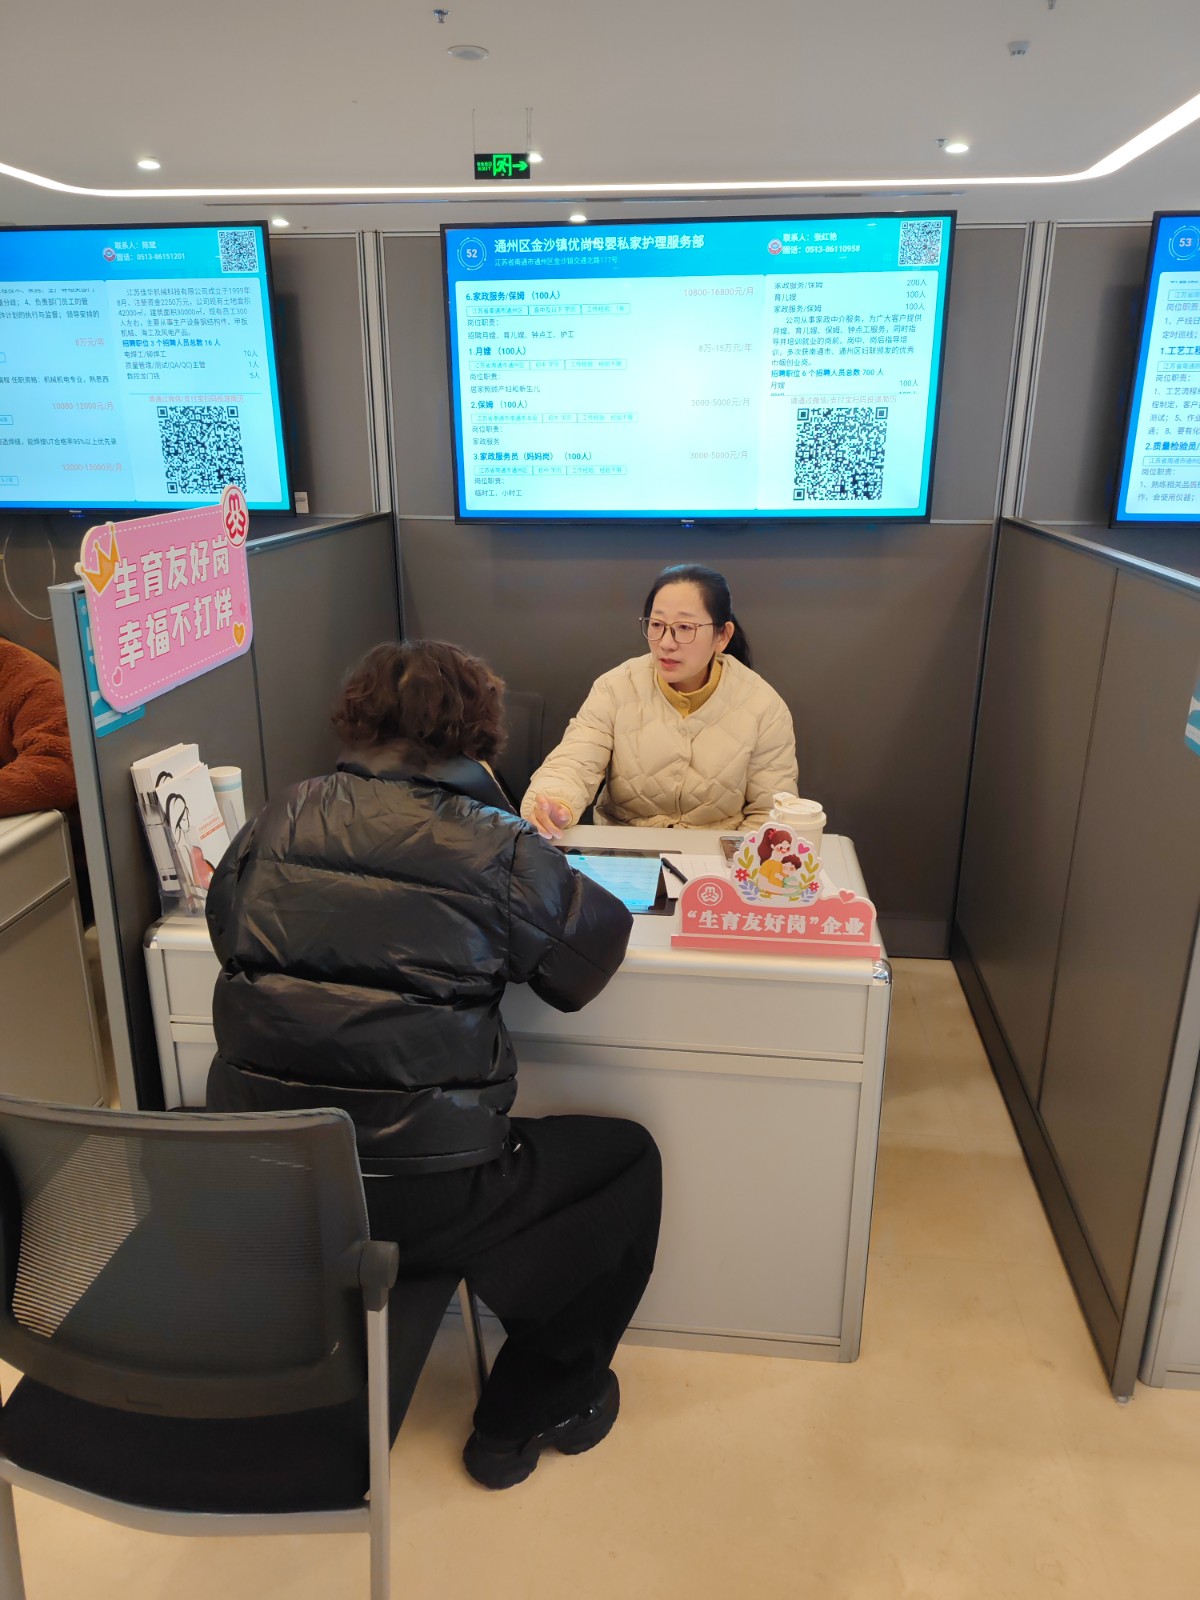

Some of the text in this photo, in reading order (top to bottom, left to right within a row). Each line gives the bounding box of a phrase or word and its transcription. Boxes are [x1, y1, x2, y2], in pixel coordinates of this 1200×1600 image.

[494, 234, 705, 254] 通州区金沙镇优尚母婴私家护理服务部
[1179, 238, 1192, 247] 53
[466, 249, 477, 258] 52
[466, 290, 561, 301] 6.家政服务/保姆 （100人）
[684, 287, 754, 296] 10800-16800元/月
[774, 293, 797, 301] 育儿嫂
[773, 305, 822, 313] 家政服务/保姆
[467, 319, 499, 327] 岗位职责：
[469, 346, 527, 356] 1.月嫂 （100人）
[1156, 374, 1191, 382] 岗位职责：
[471, 400, 528, 409] 2.保姆 （100人）
[691, 398, 750, 406] 3000-5000元/月
[473, 452, 592, 461] 3.家政服务员（妈妈岗） （100人）
[690, 451, 748, 459] 3000-5000元/月
[1141, 468, 1175, 476] 岗位职责：
[475, 489, 522, 497] 临时工、小时工
[113, 534, 230, 609] 生育友好岗
[117, 586, 233, 669] 幸福不打烊
[687, 909, 865, 935] “生育友好岗”企业
